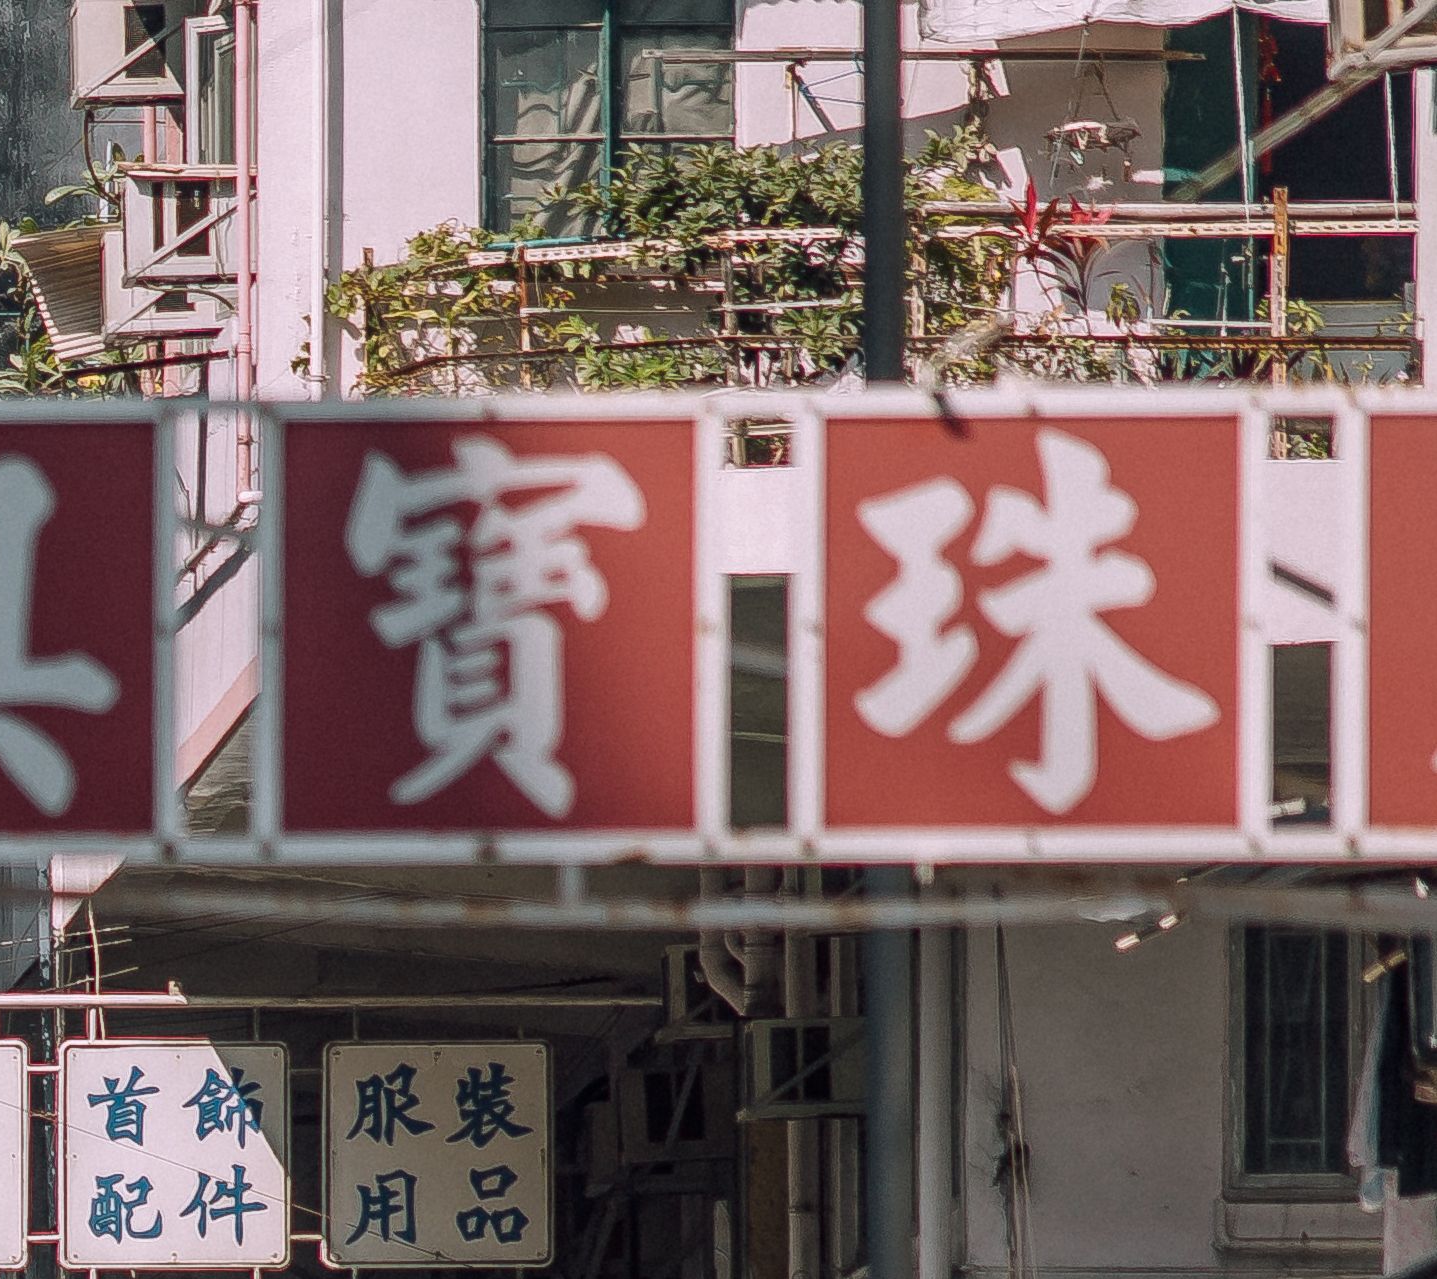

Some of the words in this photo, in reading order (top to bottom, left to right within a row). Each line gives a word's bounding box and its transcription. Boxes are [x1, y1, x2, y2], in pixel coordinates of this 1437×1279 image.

[88, 1065, 265, 1147] 首飾
[346, 1062, 534, 1147] 服裝
[88, 1164, 268, 1247] 配件
[345, 1165, 531, 1247] 用品
